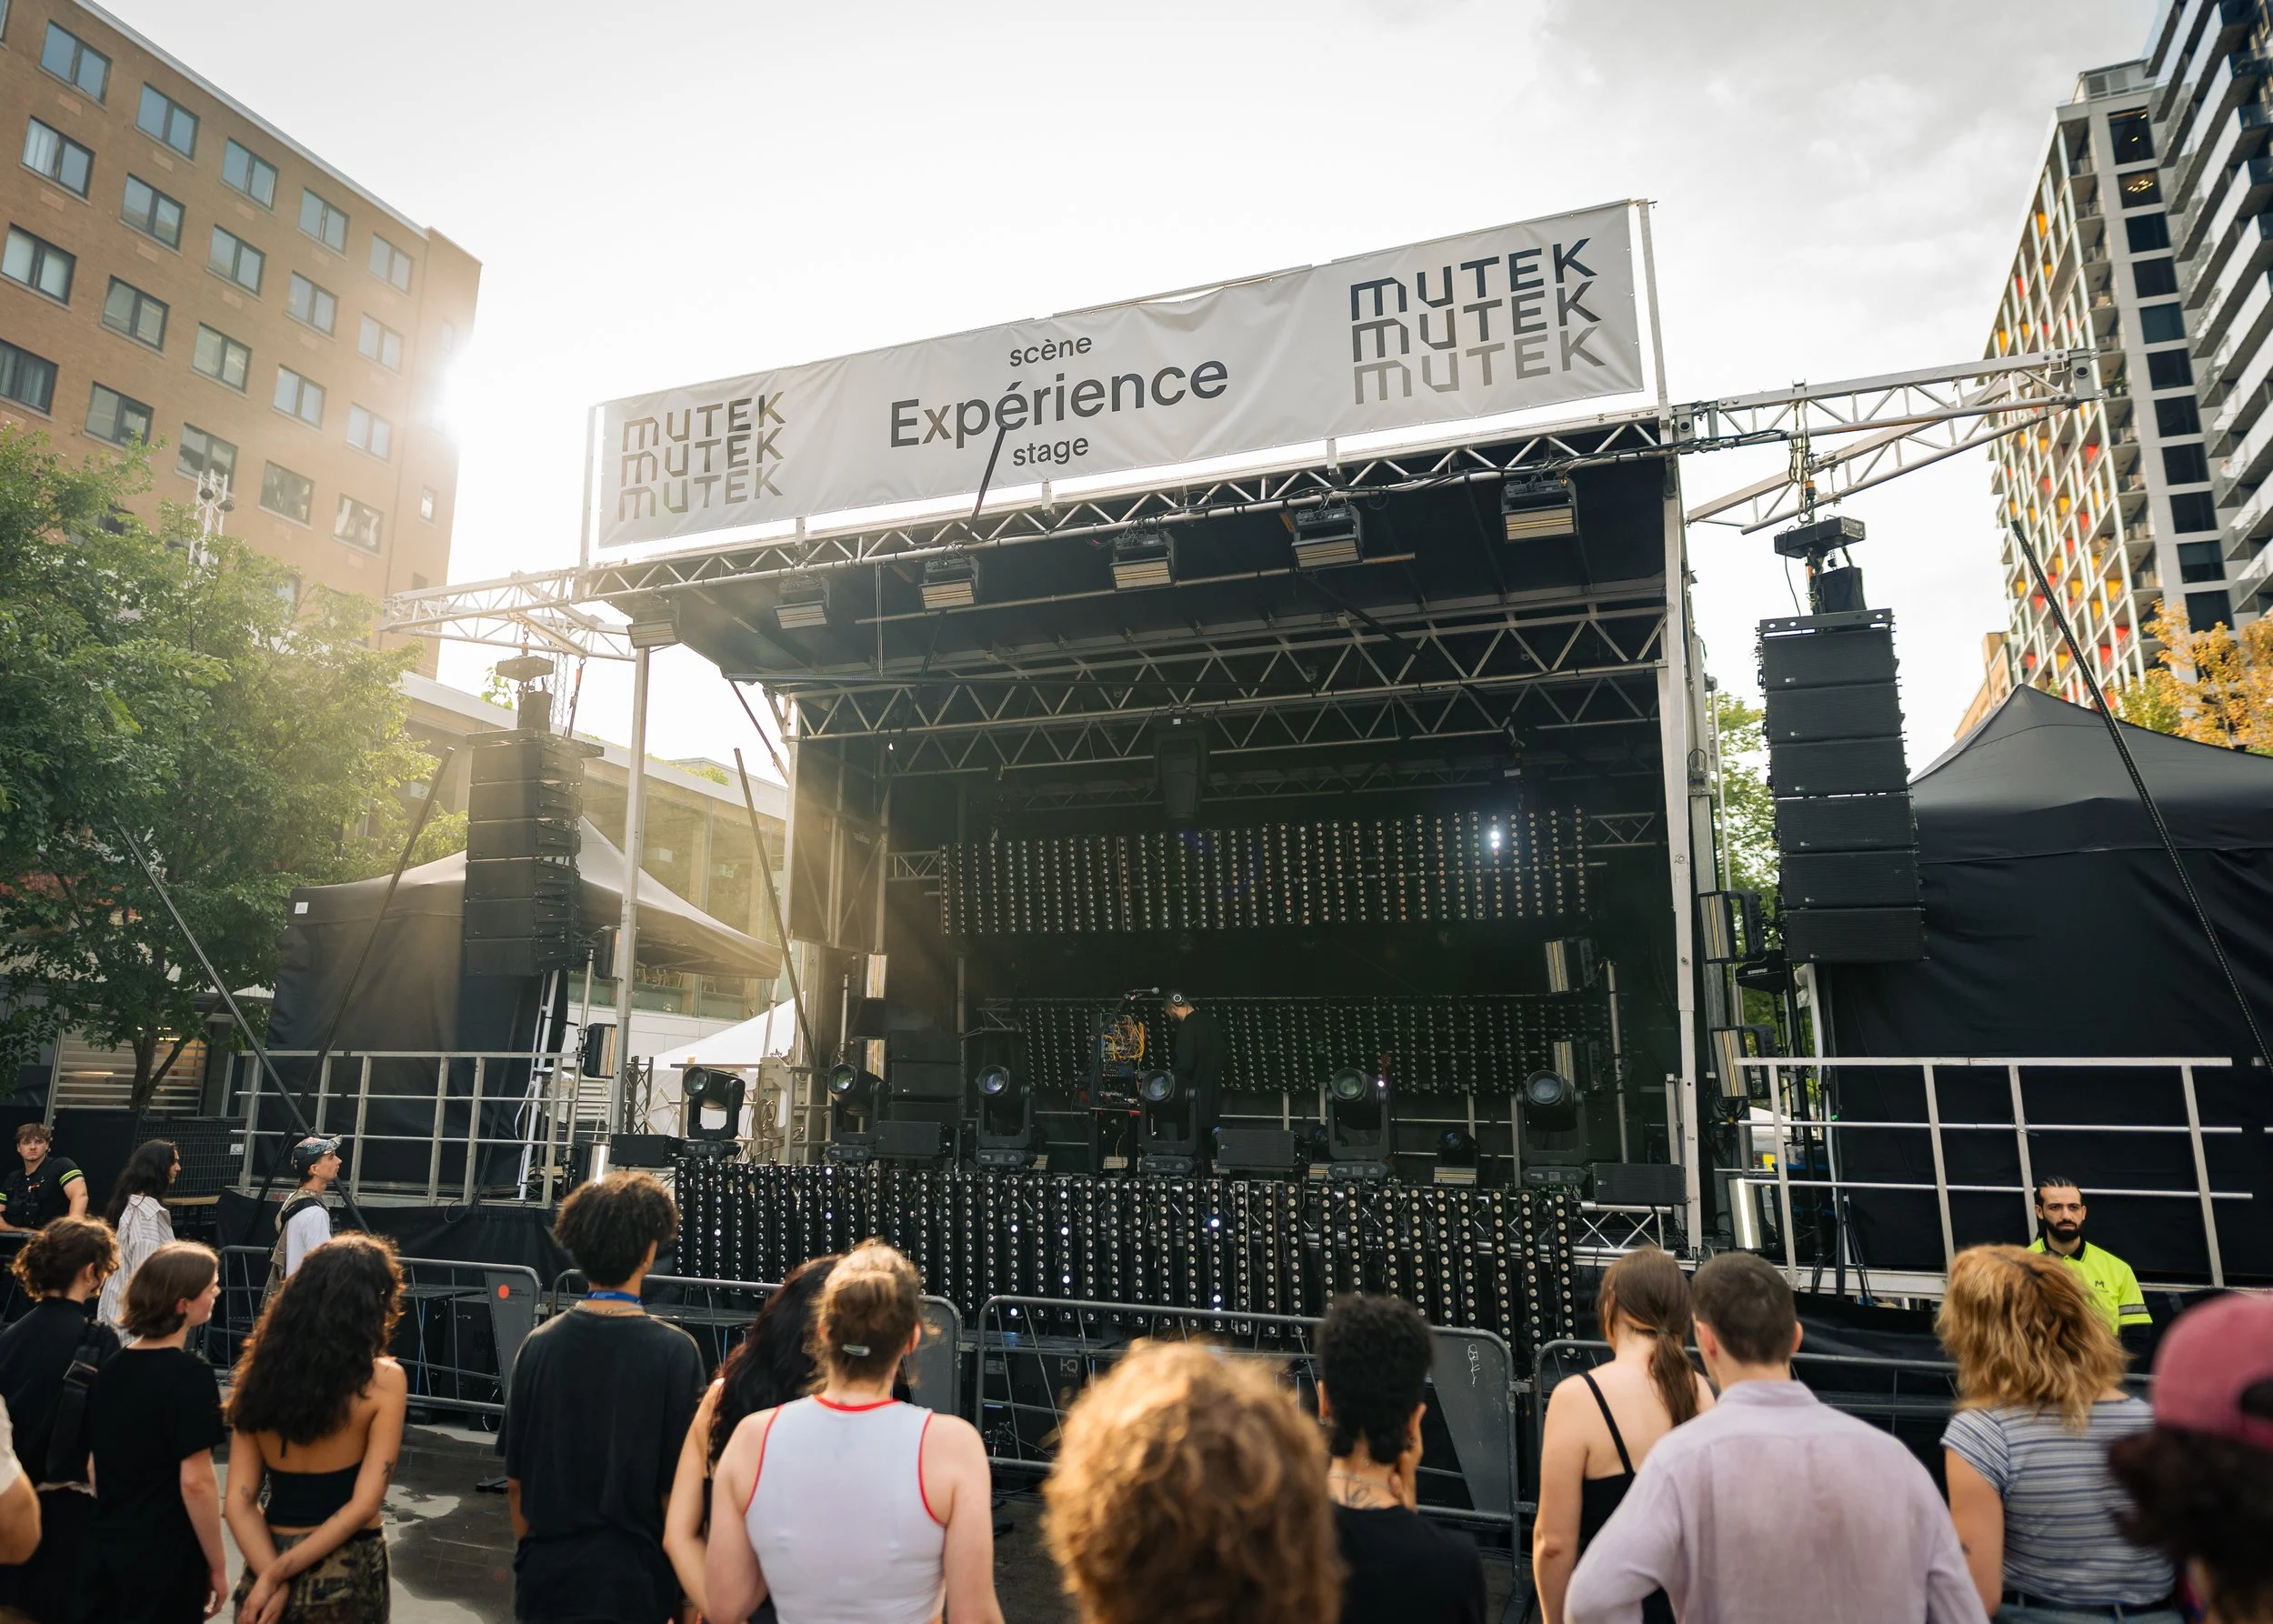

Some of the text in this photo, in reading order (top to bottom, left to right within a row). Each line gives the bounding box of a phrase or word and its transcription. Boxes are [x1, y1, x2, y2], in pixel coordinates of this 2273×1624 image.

[1009, 336, 1093, 367] scène
[890, 359, 1228, 449] Expérience
[1012, 436, 1090, 466] stage
